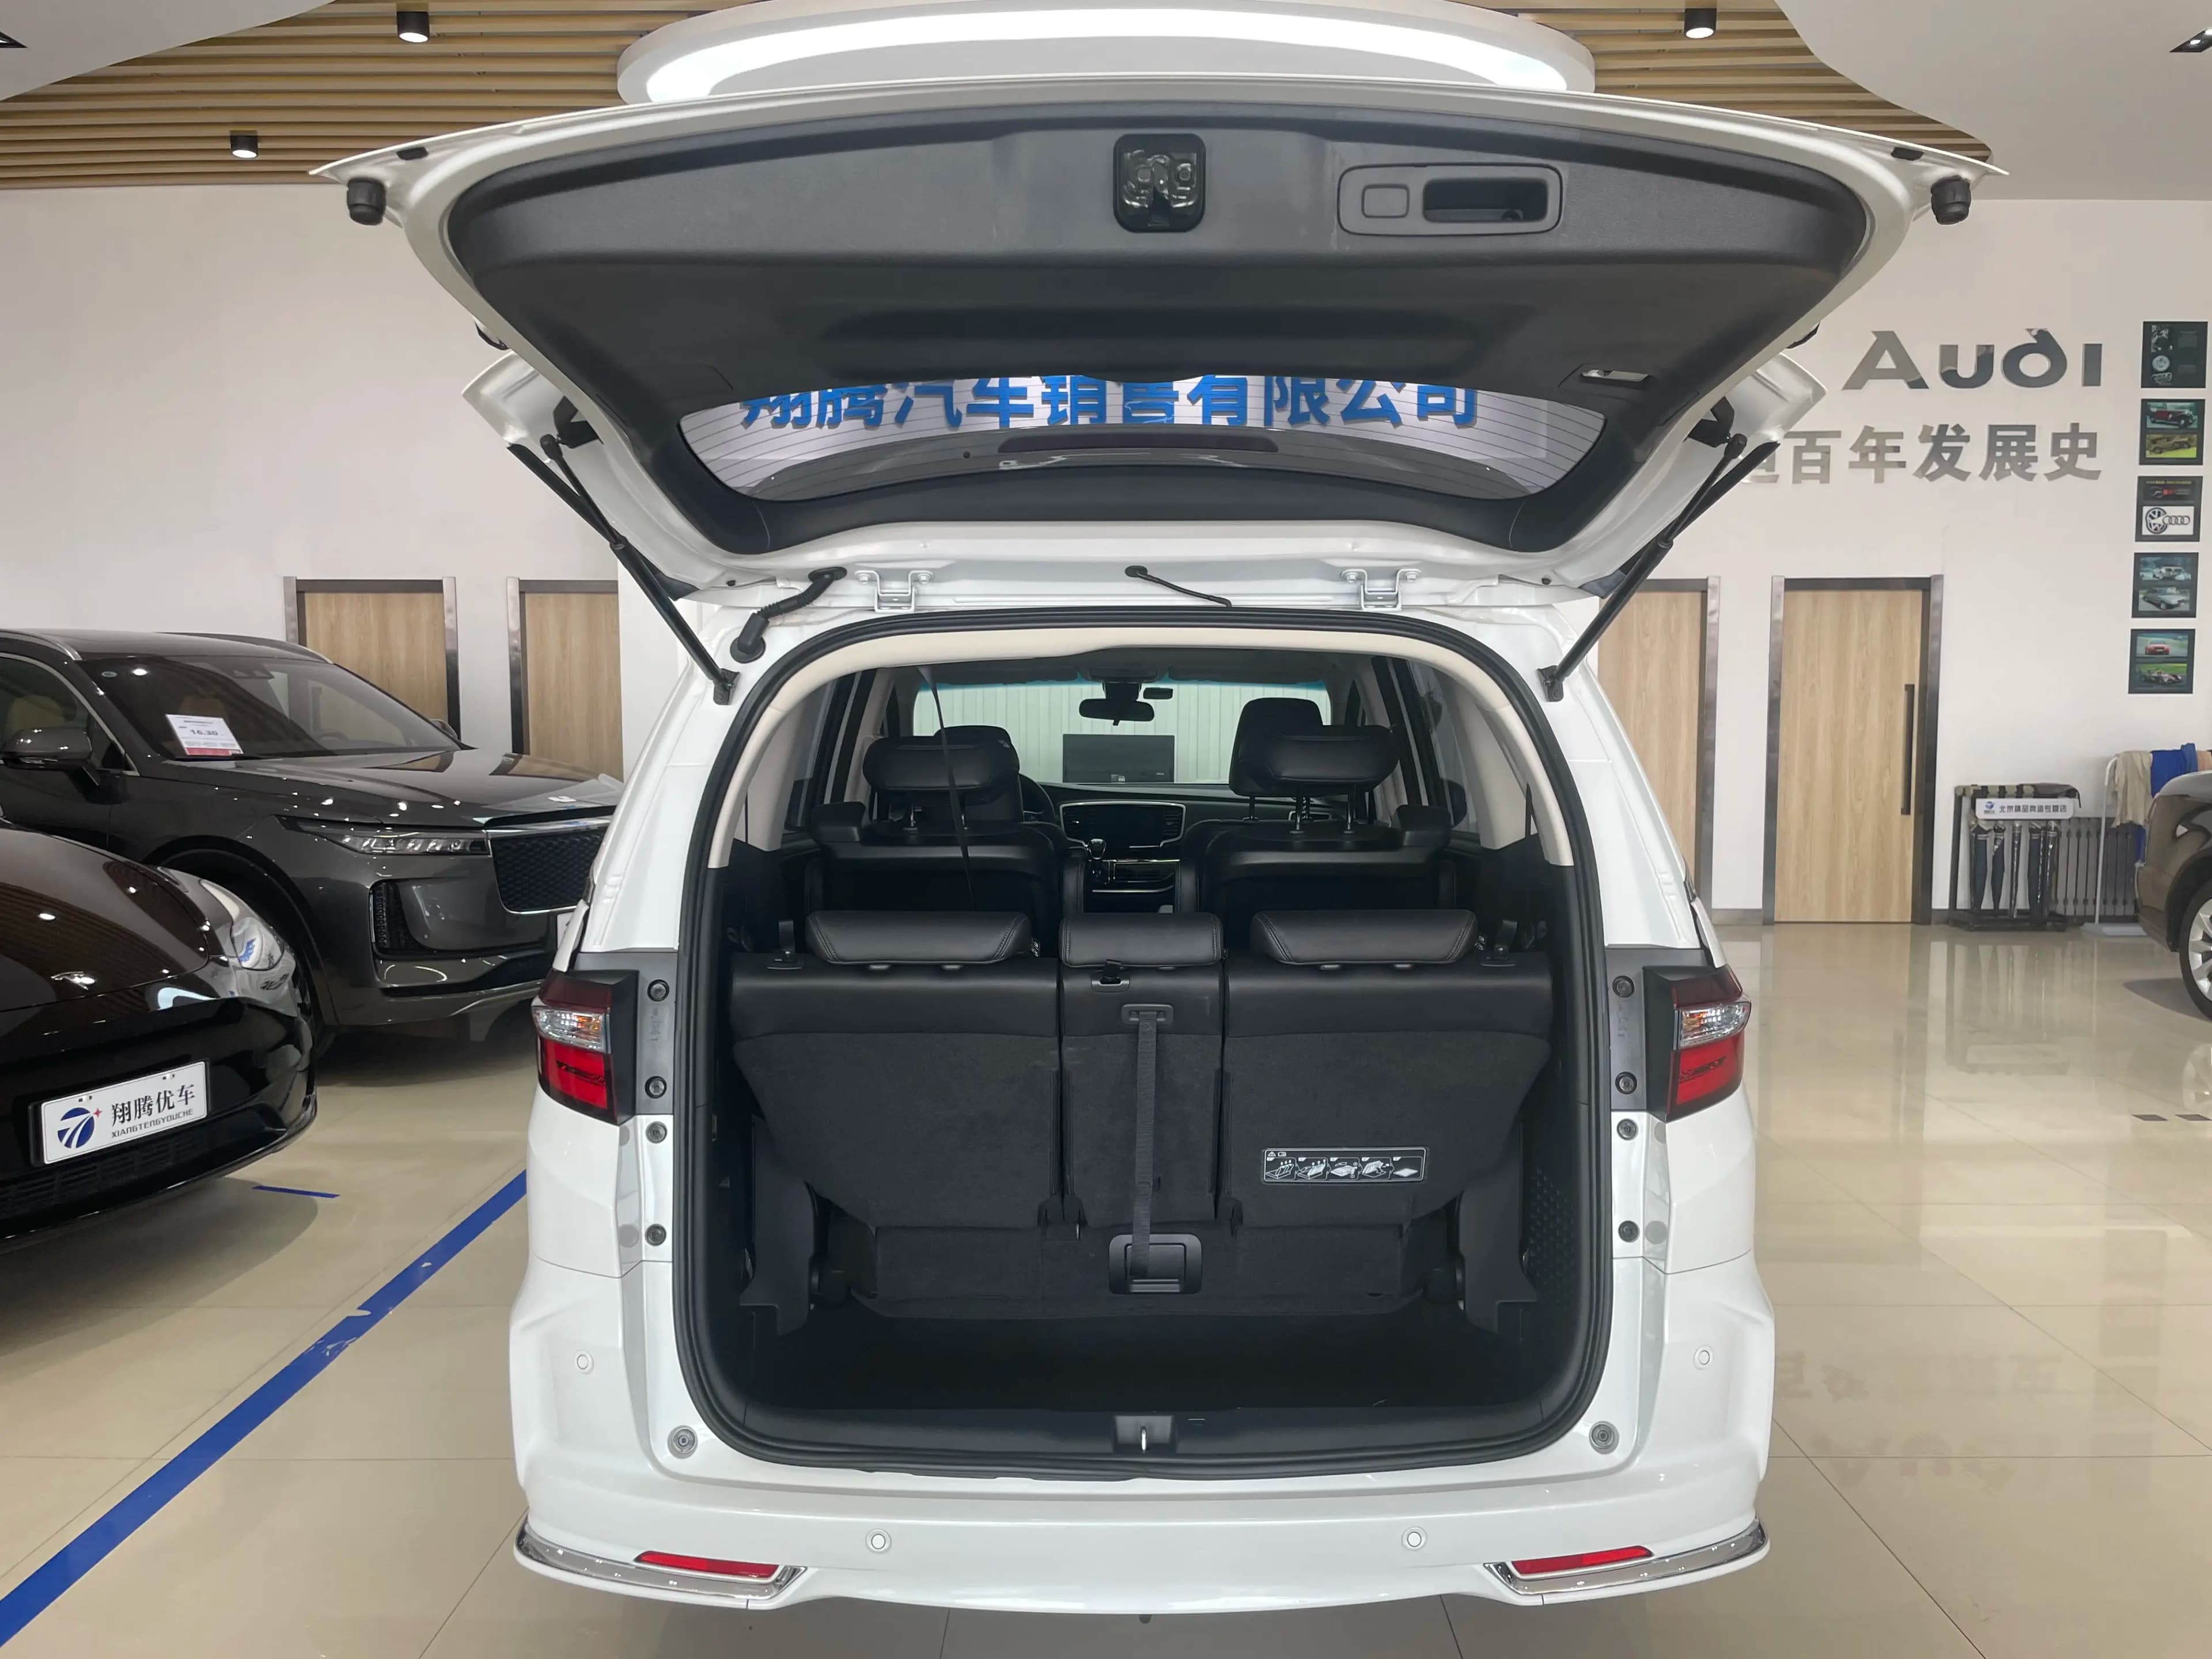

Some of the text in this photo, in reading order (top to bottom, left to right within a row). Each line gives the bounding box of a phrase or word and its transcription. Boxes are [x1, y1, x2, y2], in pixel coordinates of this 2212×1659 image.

[112, 1084, 195, 1127] 翔腾优车
[112, 1108, 194, 1138] XIANGTENGYOUCHE
